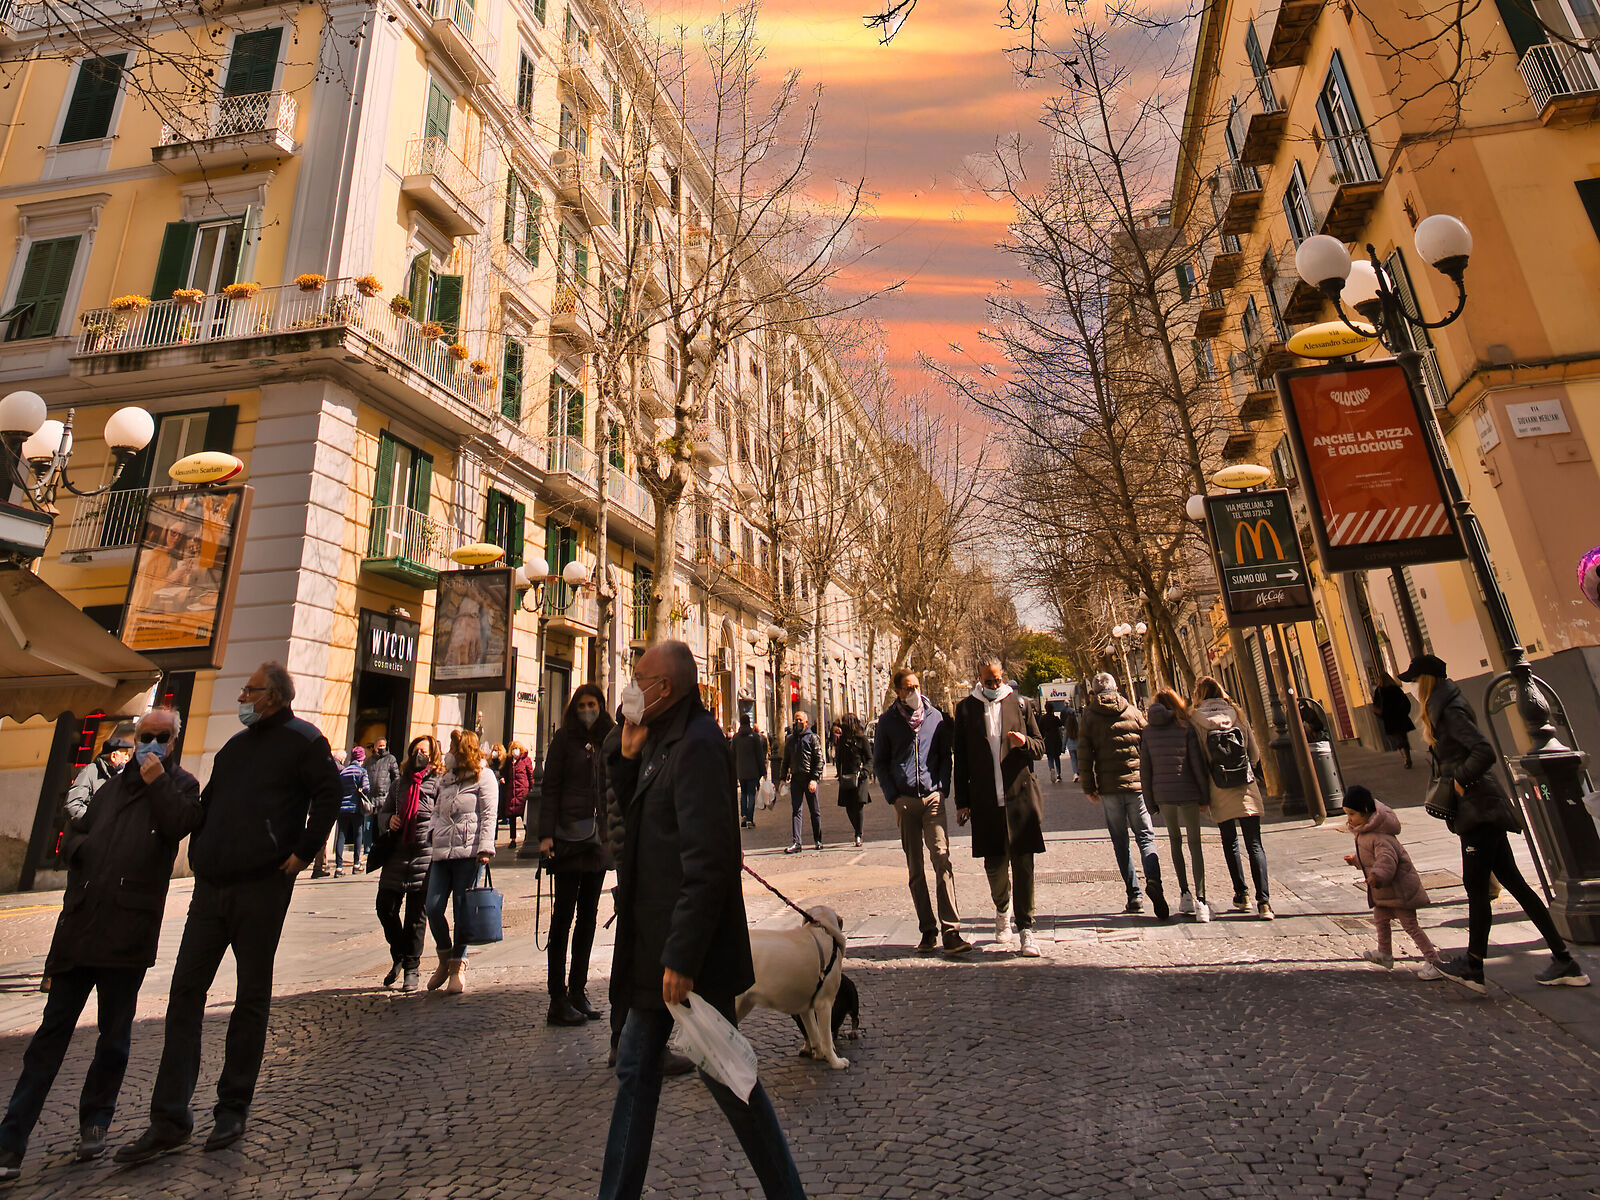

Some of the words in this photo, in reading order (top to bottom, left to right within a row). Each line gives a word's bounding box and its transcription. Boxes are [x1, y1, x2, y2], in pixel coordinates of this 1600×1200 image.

[1303, 339, 1341, 351] Alessandro
[1329, 387, 1371, 407] GOLOCIOUS
[1313, 432, 1356, 447] ANCHE
[1357, 431, 1375, 442] LA
[1375, 426, 1414, 440] PIZZA
[1327, 445, 1337, 457] È
[1338, 439, 1404, 456] GOLOCIOUS
[1225, 503, 1237, 512] VIA
[1231, 574, 1254, 585] SIAMO
[1254, 572, 1268, 583] QUI
[1256, 589, 1285, 606] McCafé
[372, 628, 414, 662] WYCON
[374, 660, 403, 672] cosmetics
